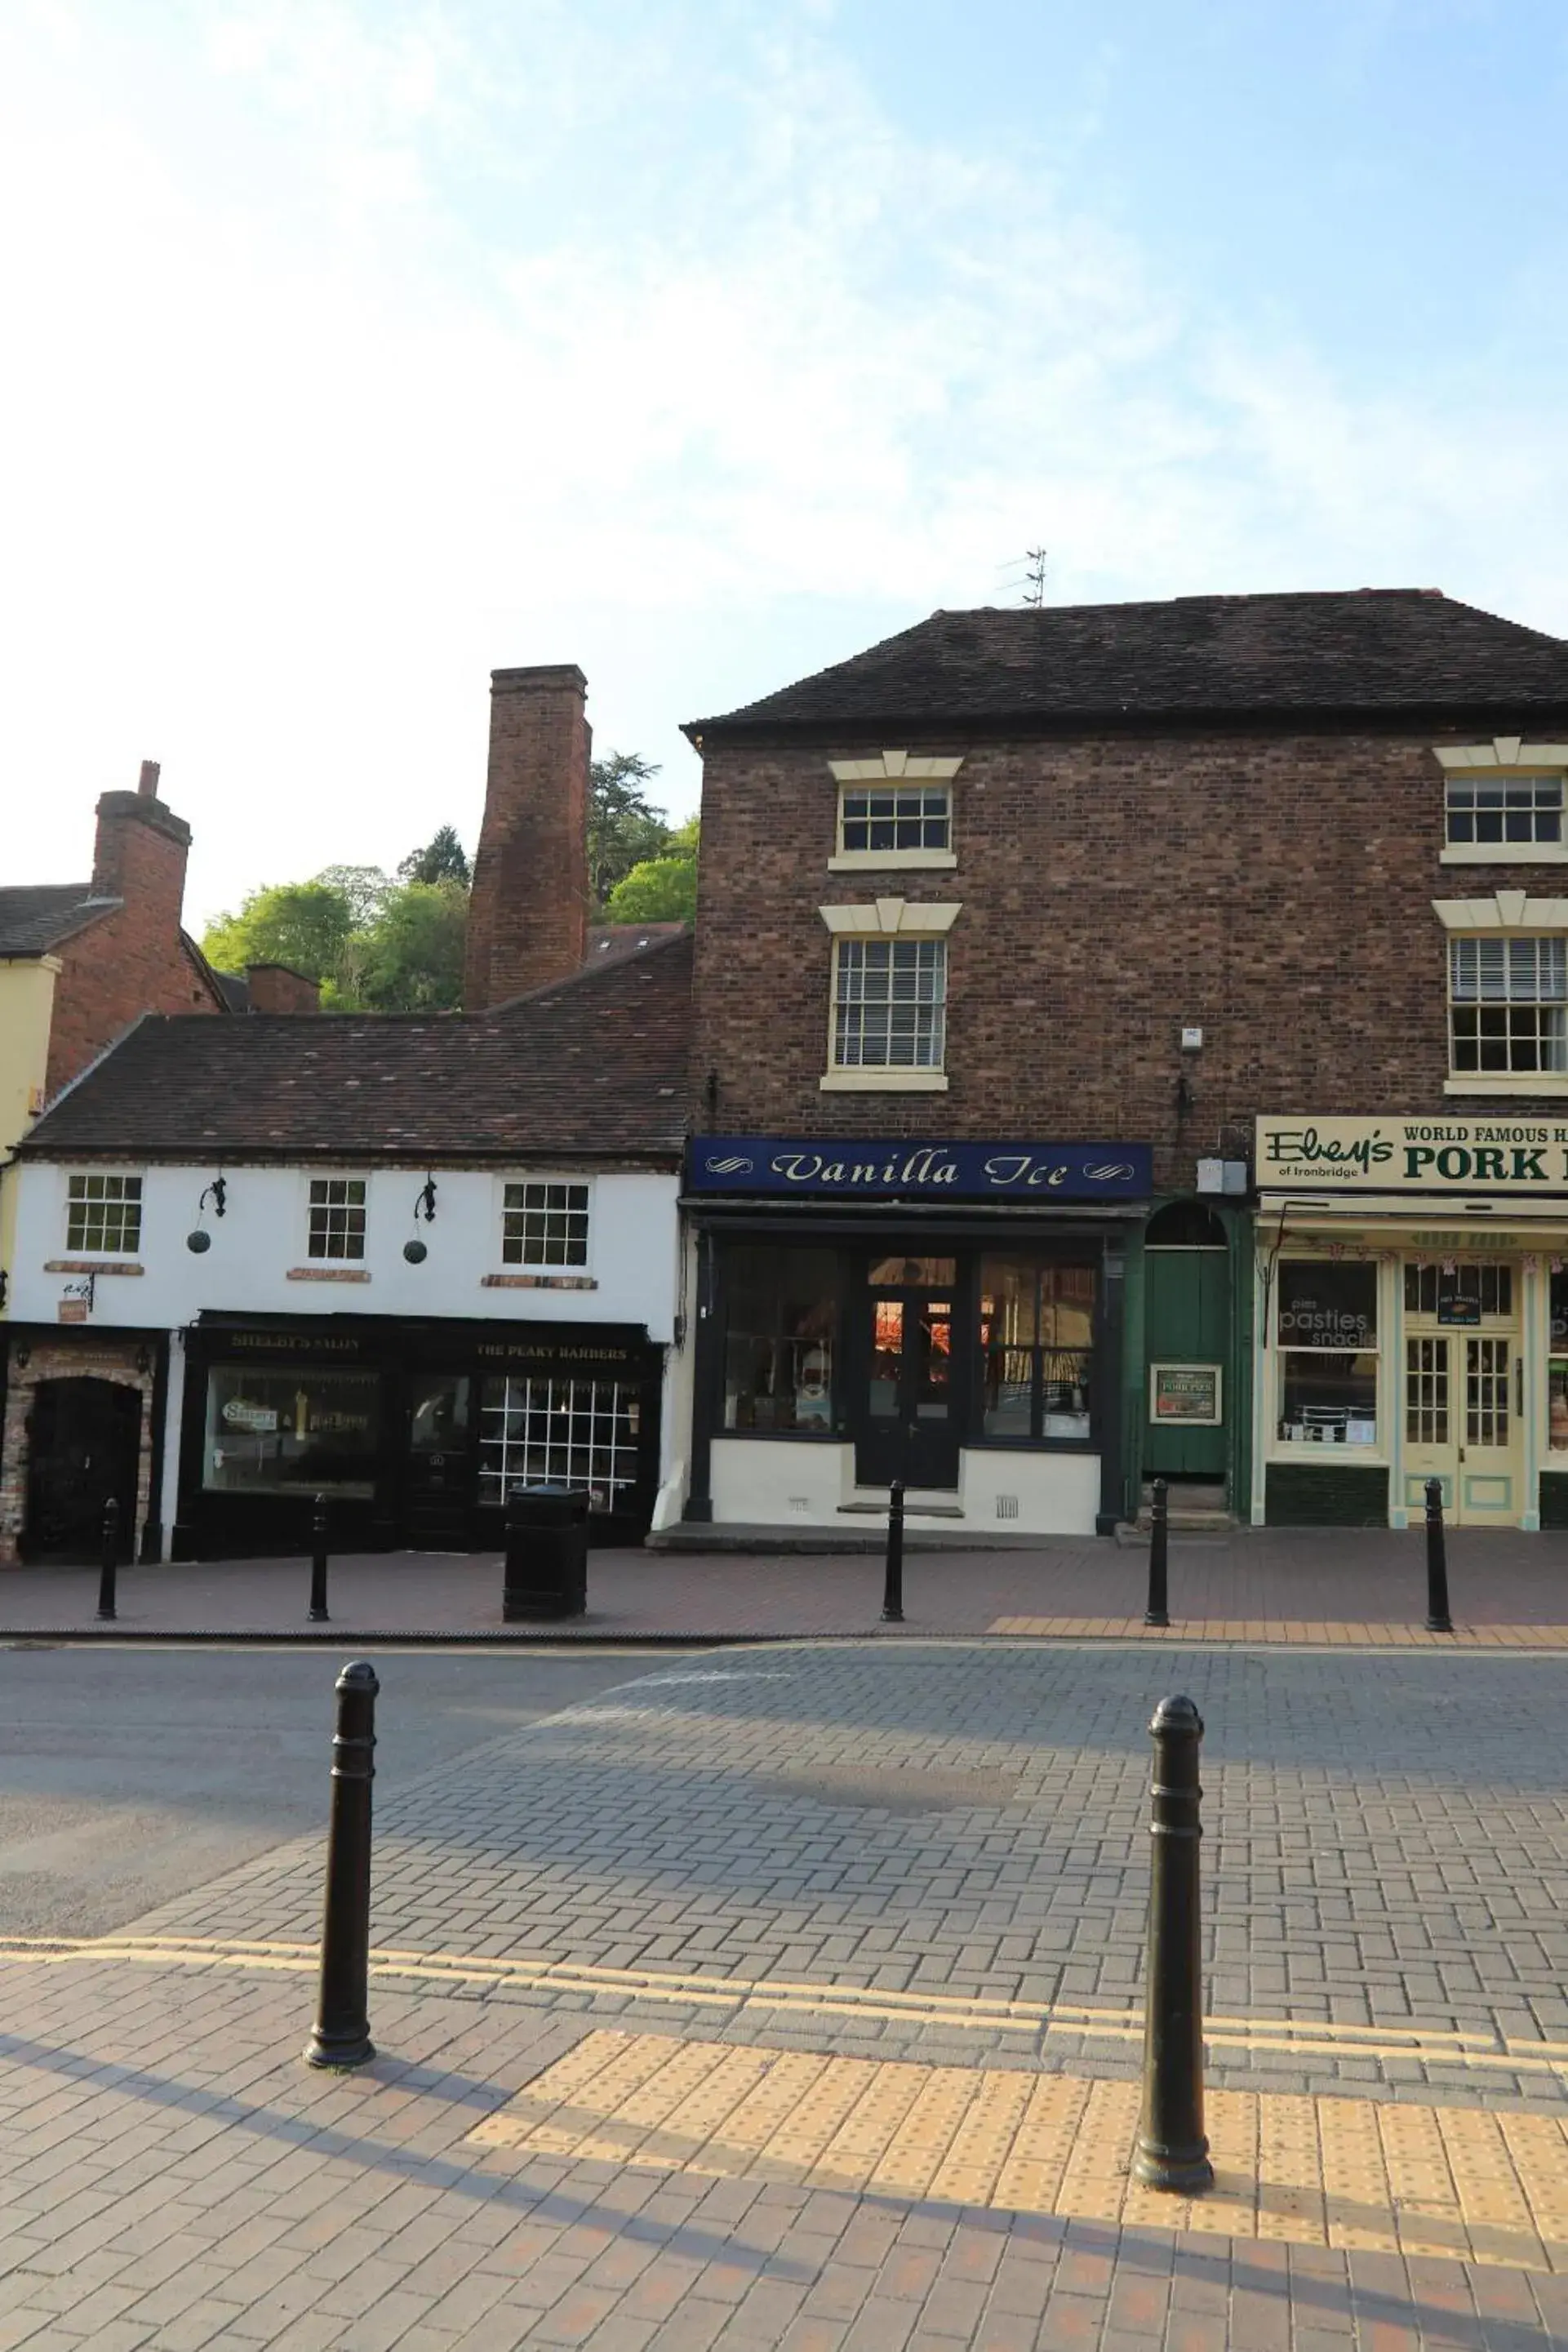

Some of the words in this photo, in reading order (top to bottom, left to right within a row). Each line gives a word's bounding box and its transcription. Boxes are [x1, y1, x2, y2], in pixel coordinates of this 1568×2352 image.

[1403, 1127, 1468, 1142] WORLD
[1474, 1127, 1548, 1142] FAMOUS
[771, 1148, 959, 1185] Vanilla
[984, 1156, 1068, 1186] Ice
[1279, 1166, 1291, 1176] of
[1294, 1166, 1359, 1179] Ironbridge
[1402, 1146, 1549, 1180] PORK
[1279, 1309, 1367, 1332] pasties
[477, 1344, 504, 1355] THE
[558, 1347, 628, 1360] BARBERS
